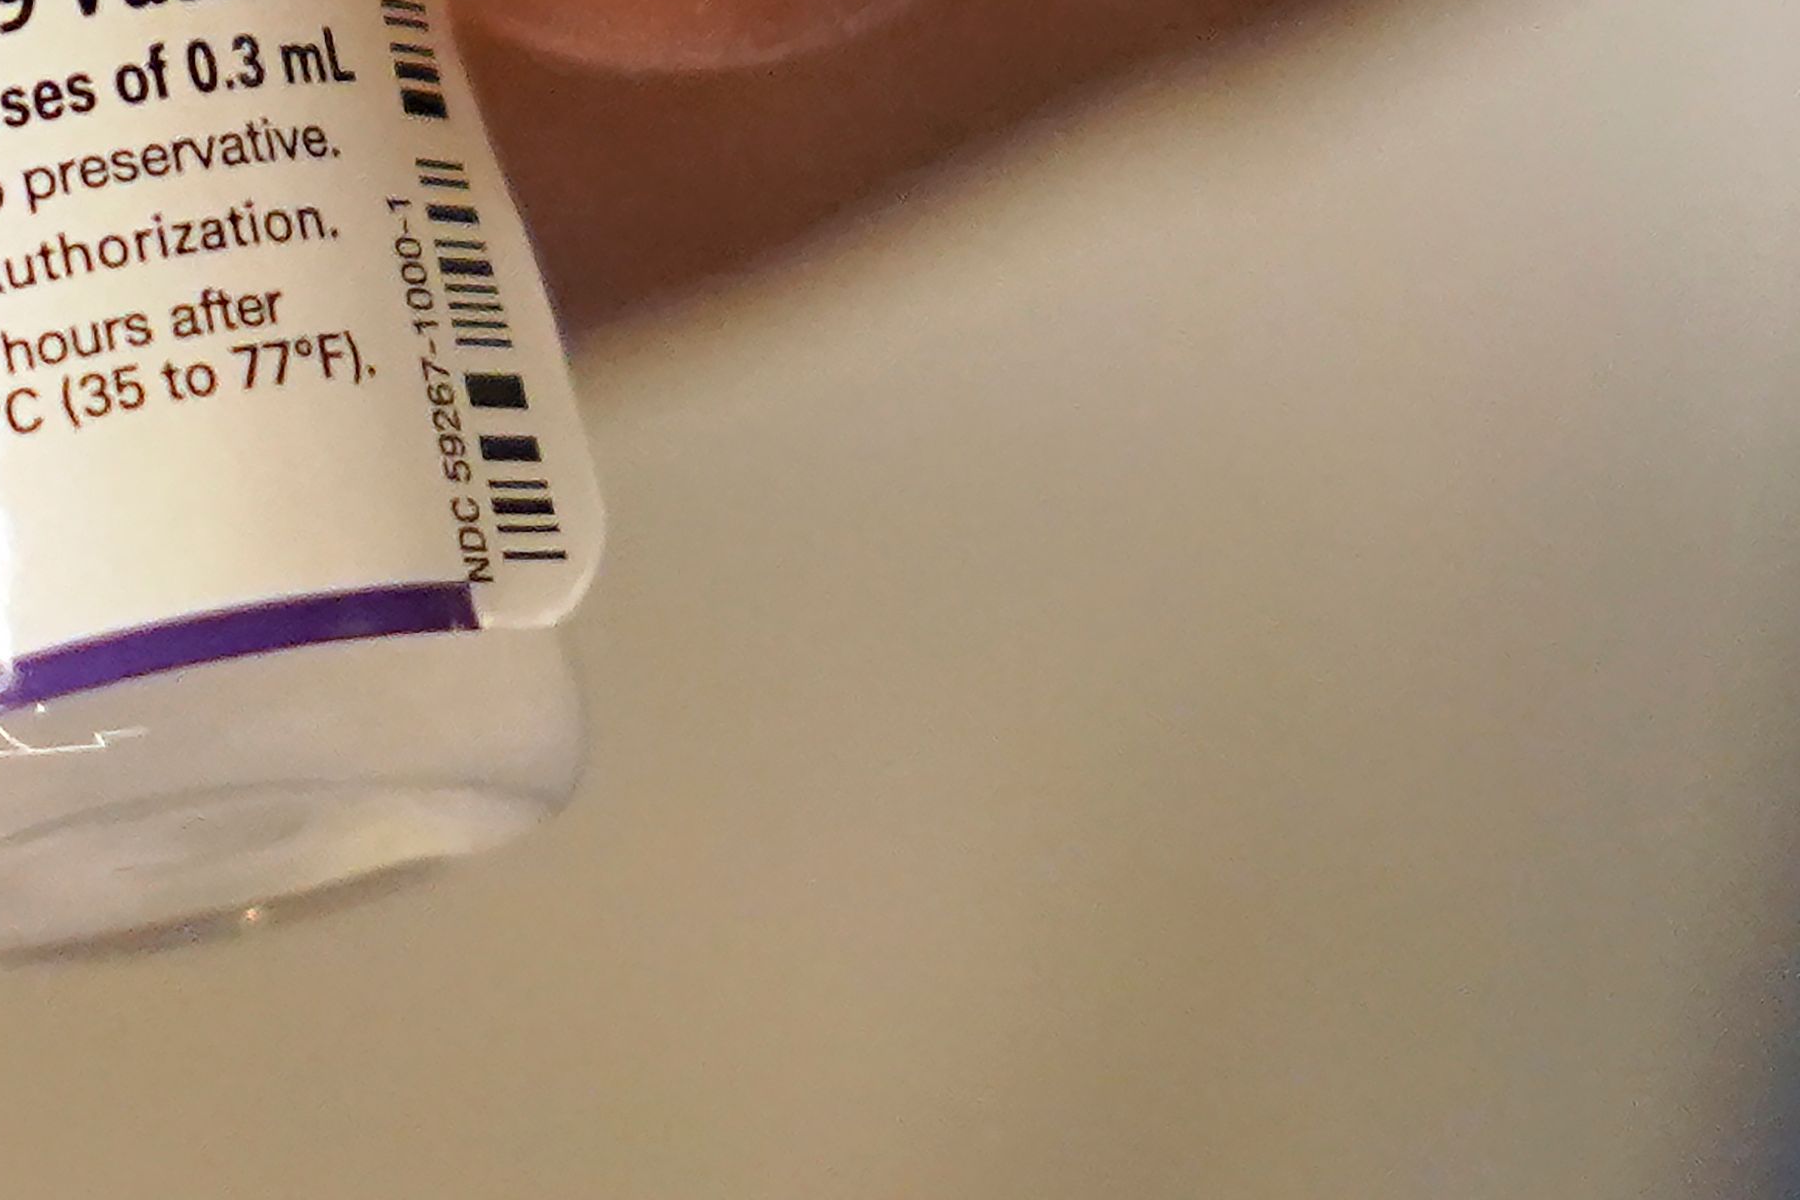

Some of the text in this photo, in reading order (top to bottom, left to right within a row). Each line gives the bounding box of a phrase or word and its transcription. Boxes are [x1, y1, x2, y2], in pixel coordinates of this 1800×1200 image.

[115, 41, 168, 104] of
[187, 32, 265, 93] 0.3
[280, 26, 357, 85] mL
[23, 117, 341, 214] preservative.
[1, 312, 153, 375] hours
[172, 287, 283, 340] after
[61, 364, 146, 431] (35
[161, 360, 218, 400] to
[231, 330, 377, 390] 77°F).
[384, 195, 495, 584] NDC 59267-1000-1
